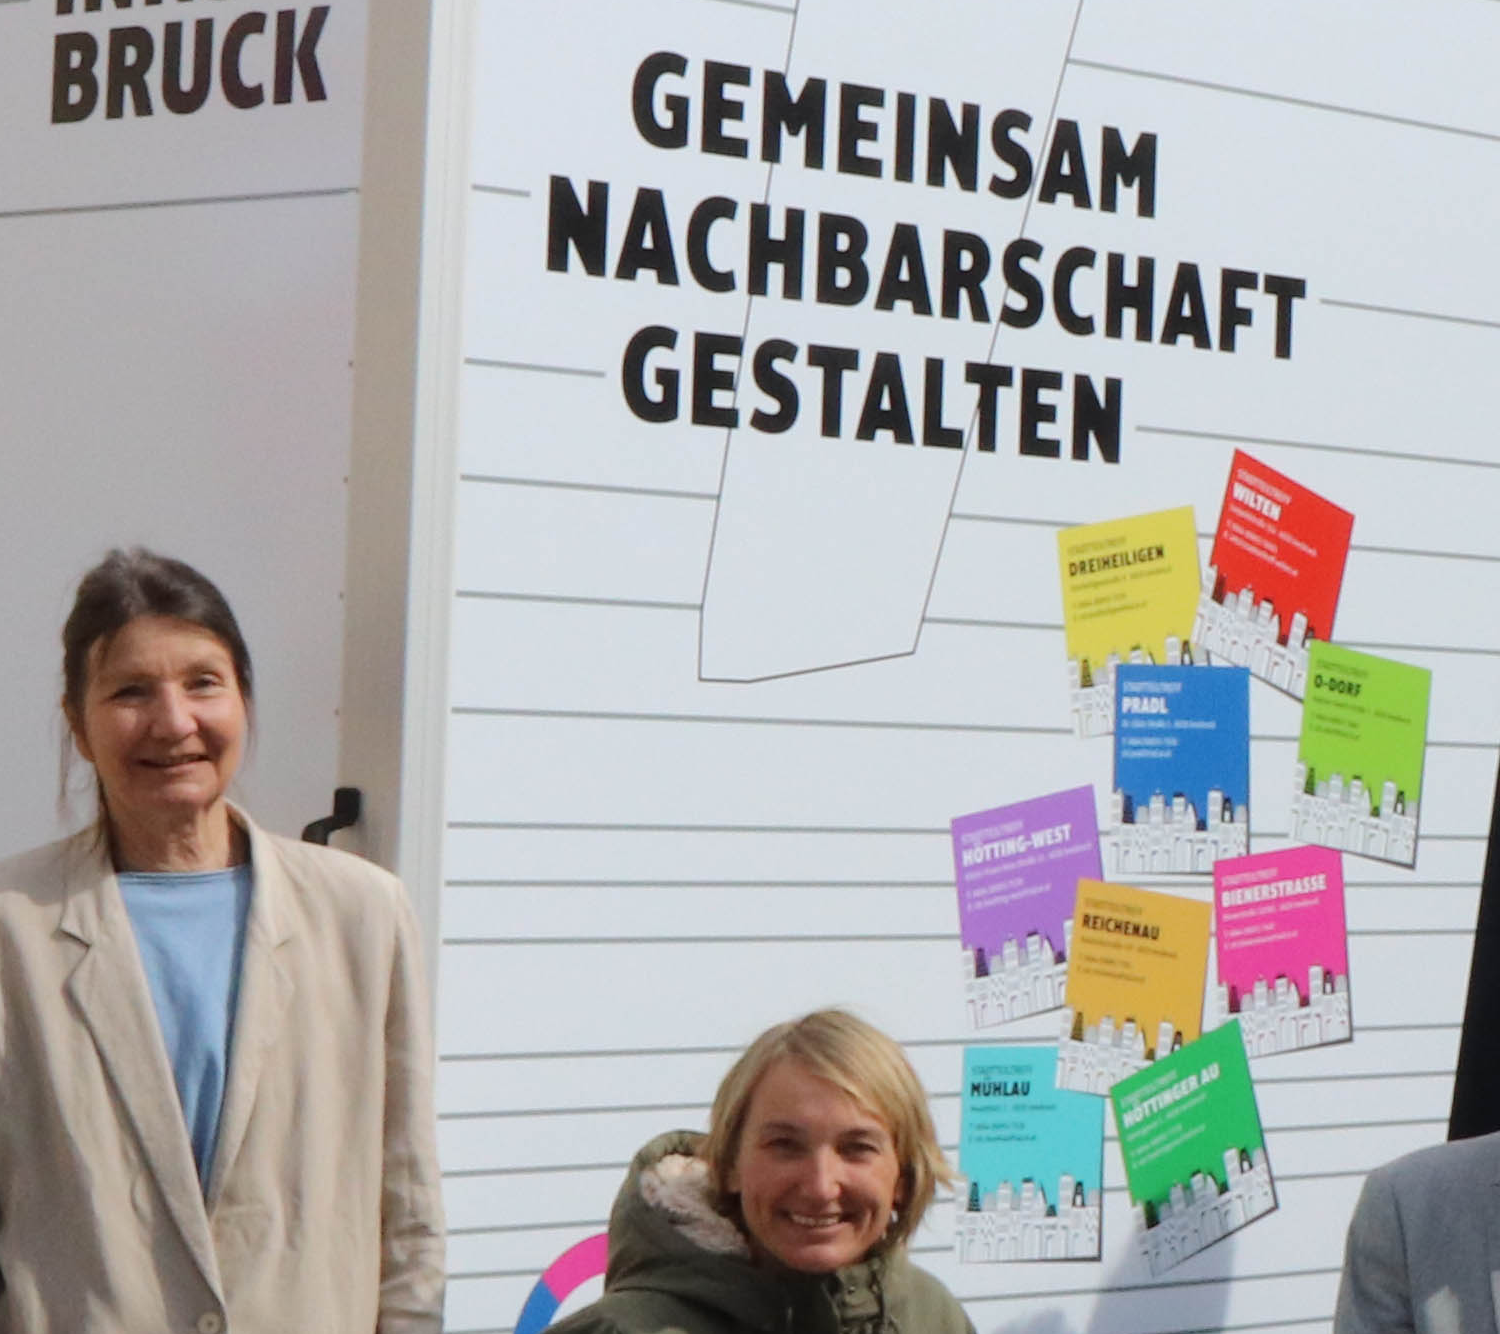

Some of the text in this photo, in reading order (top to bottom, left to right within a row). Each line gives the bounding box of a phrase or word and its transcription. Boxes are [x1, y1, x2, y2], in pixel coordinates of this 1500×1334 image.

[50, 5, 331, 125] BRUCK
[631, 50, 1159, 219] GEMEINSAM
[546, 174, 1306, 360] NACHBARSCHAFT
[621, 325, 1124, 465] GESTALTEN
[1232, 481, 1282, 522] WILTEN
[1069, 545, 1165, 577] DREIHEILIGEN
[1122, 696, 1168, 715] PRADL
[1082, 913, 1160, 941] REICHENAU
